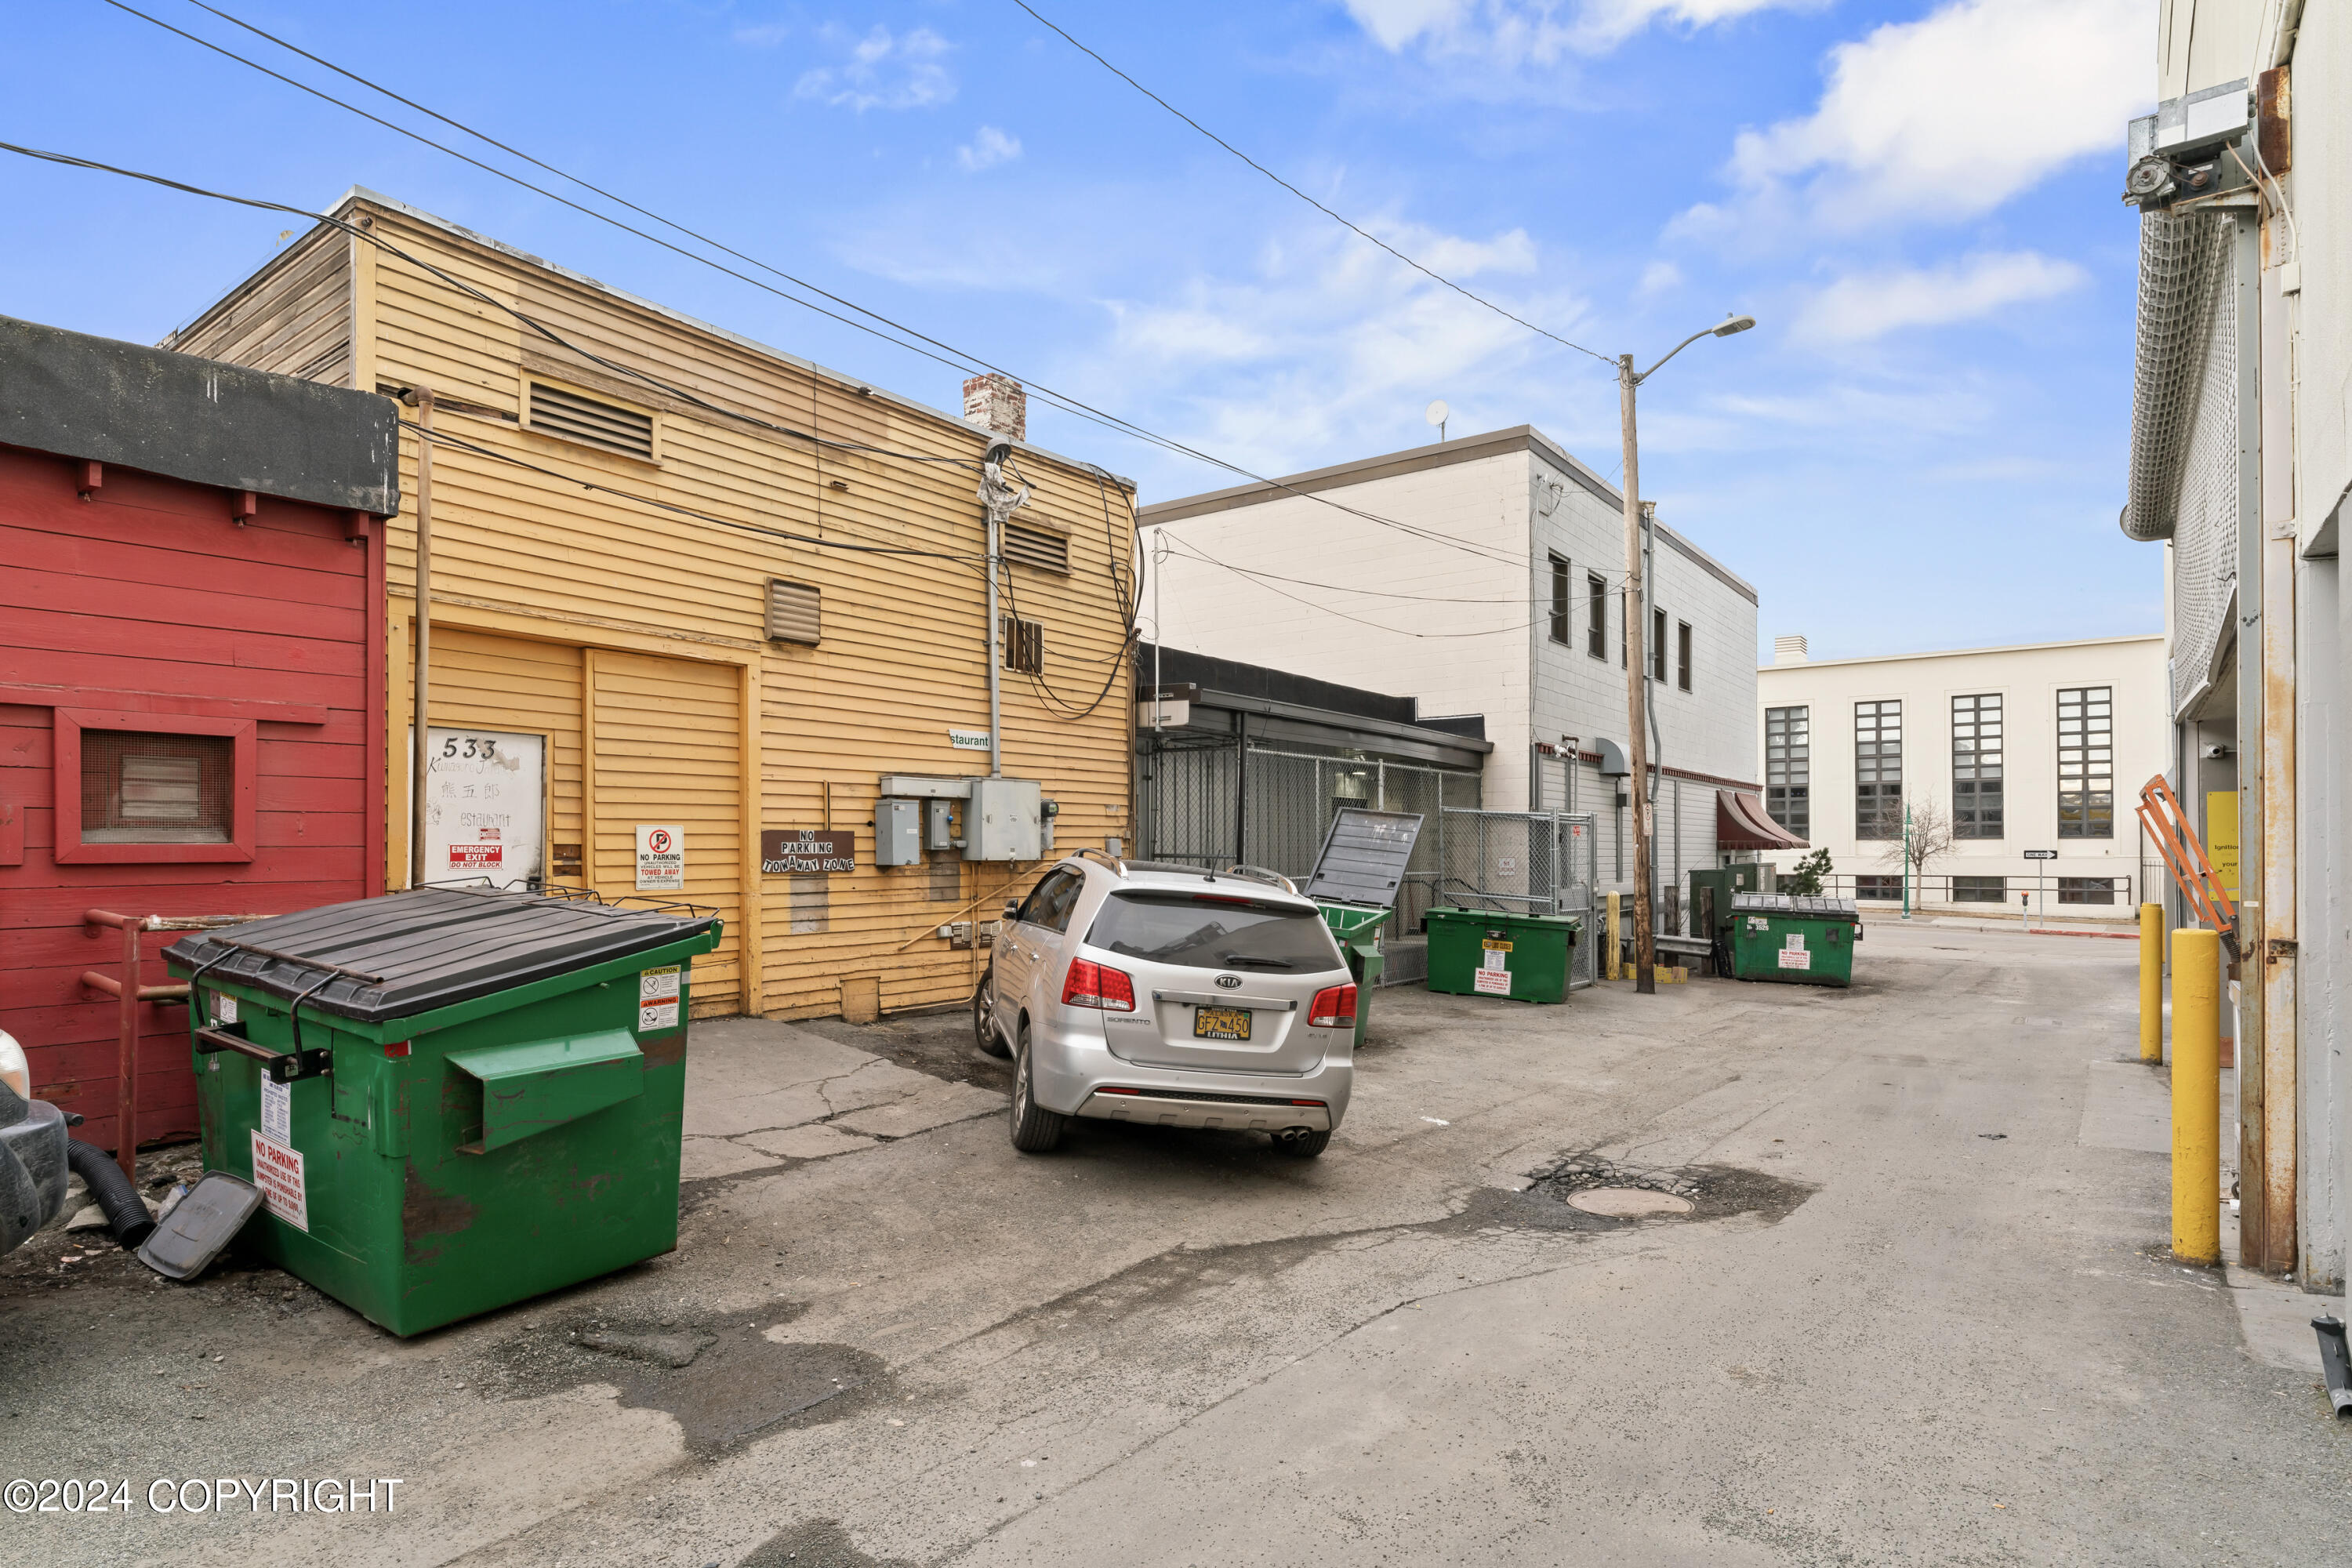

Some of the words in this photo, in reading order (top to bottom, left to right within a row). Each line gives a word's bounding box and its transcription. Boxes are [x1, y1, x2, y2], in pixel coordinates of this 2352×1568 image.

[951, 734, 988, 746] staurant
[443, 737, 496, 759] 533
[800, 831, 814, 841] NO
[782, 843, 832, 853] PARKING
[824, 859, 854, 870] ZONE
[1220, 978, 1238, 987] KIA
[1198, 1016, 1219, 1030] GFZ
[1229, 1018, 1248, 1033] 450
[256, 1139, 265, 1157] NO
[268, 1146, 299, 1174] PARKING
[257, 1159, 279, 1177] UNAUTHORIZED
